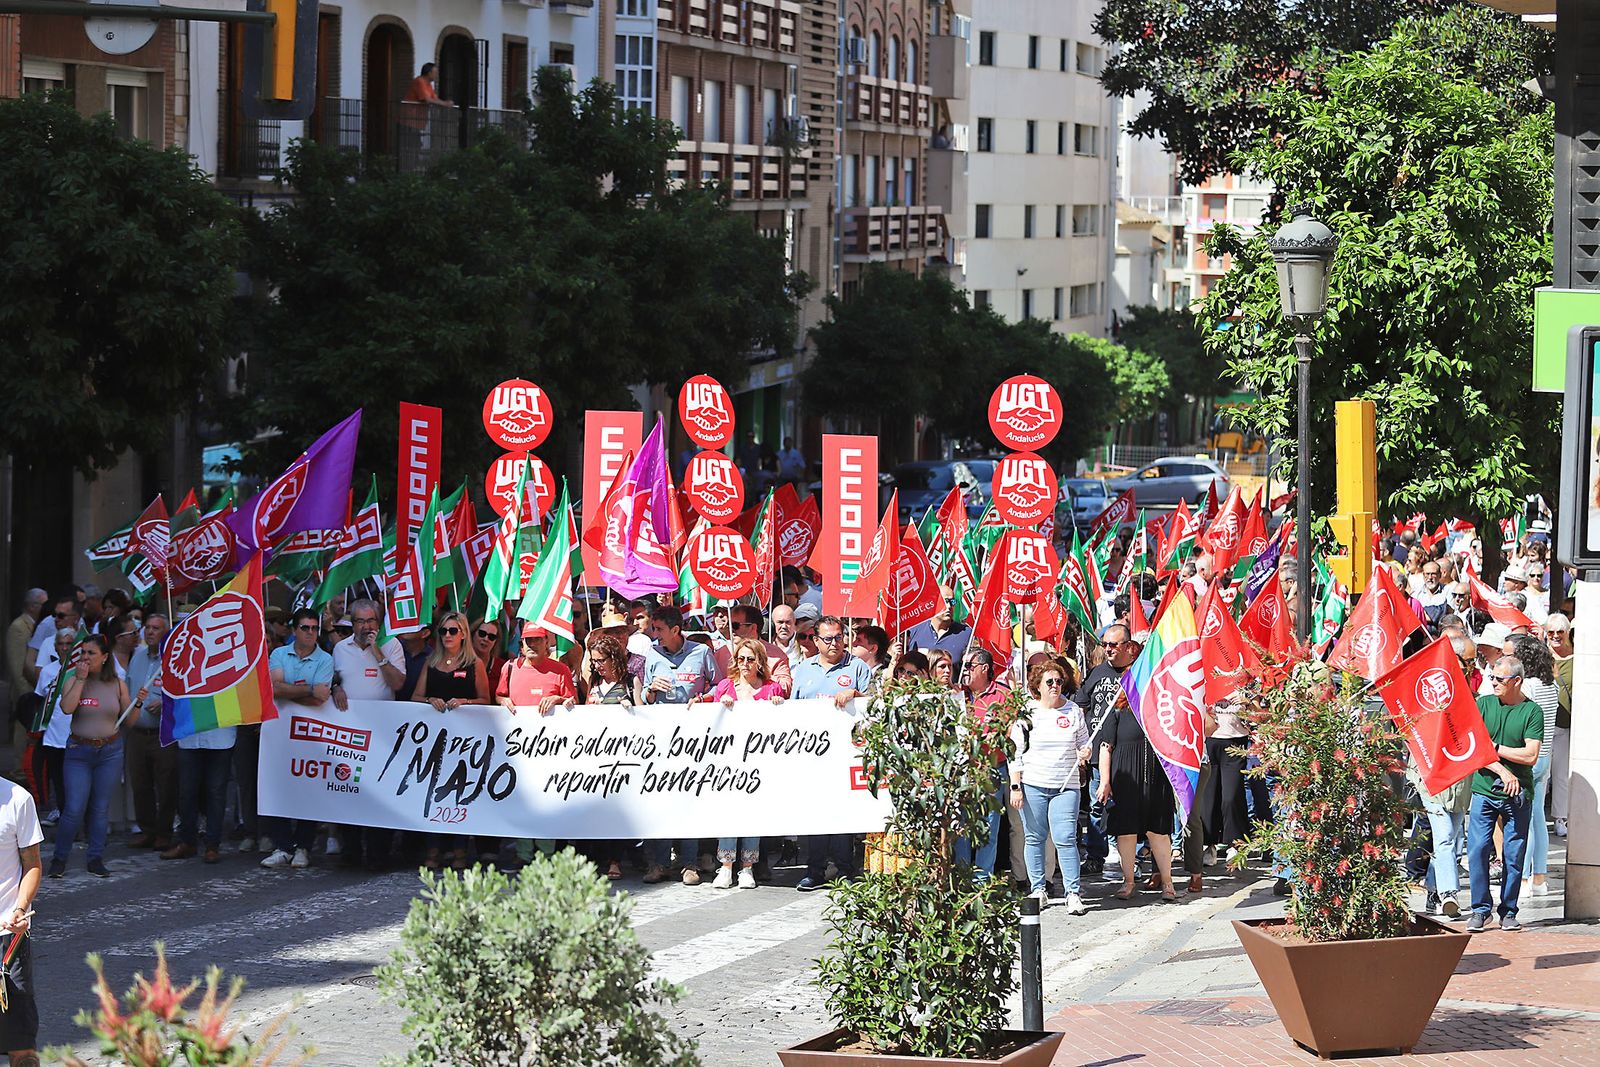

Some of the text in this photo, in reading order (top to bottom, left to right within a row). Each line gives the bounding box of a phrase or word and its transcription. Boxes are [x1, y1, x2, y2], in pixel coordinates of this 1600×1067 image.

[492, 387, 541, 413] UGT
[686, 382, 724, 411] UGT
[999, 383, 1051, 411] UGT
[499, 432, 537, 444] Andalucía
[694, 430, 724, 442] Andalucía
[1005, 431, 1046, 443] Andalucía
[693, 458, 733, 488] UGT
[1001, 459, 1048, 487] UGT
[701, 505, 733, 517] Andalucía
[1006, 506, 1043, 518] Andalucía
[699, 533, 744, 562] UGT
[707, 579, 743, 595] Andalucía
[199, 601, 249, 686] UGT
[1431, 671, 1454, 707] UGT
[326, 745, 367, 762] Huelva
[450, 736, 475, 756] DE
[504, 726, 569, 760] Subir
[669, 725, 735, 763] bajar
[743, 727, 832, 764] precios
[291, 757, 332, 780] UGT
[396, 727, 518, 818] MAYO
[542, 760, 763, 801] repartir beneficios
[326, 781, 360, 795] Huelva
[429, 806, 468, 825] 2023
